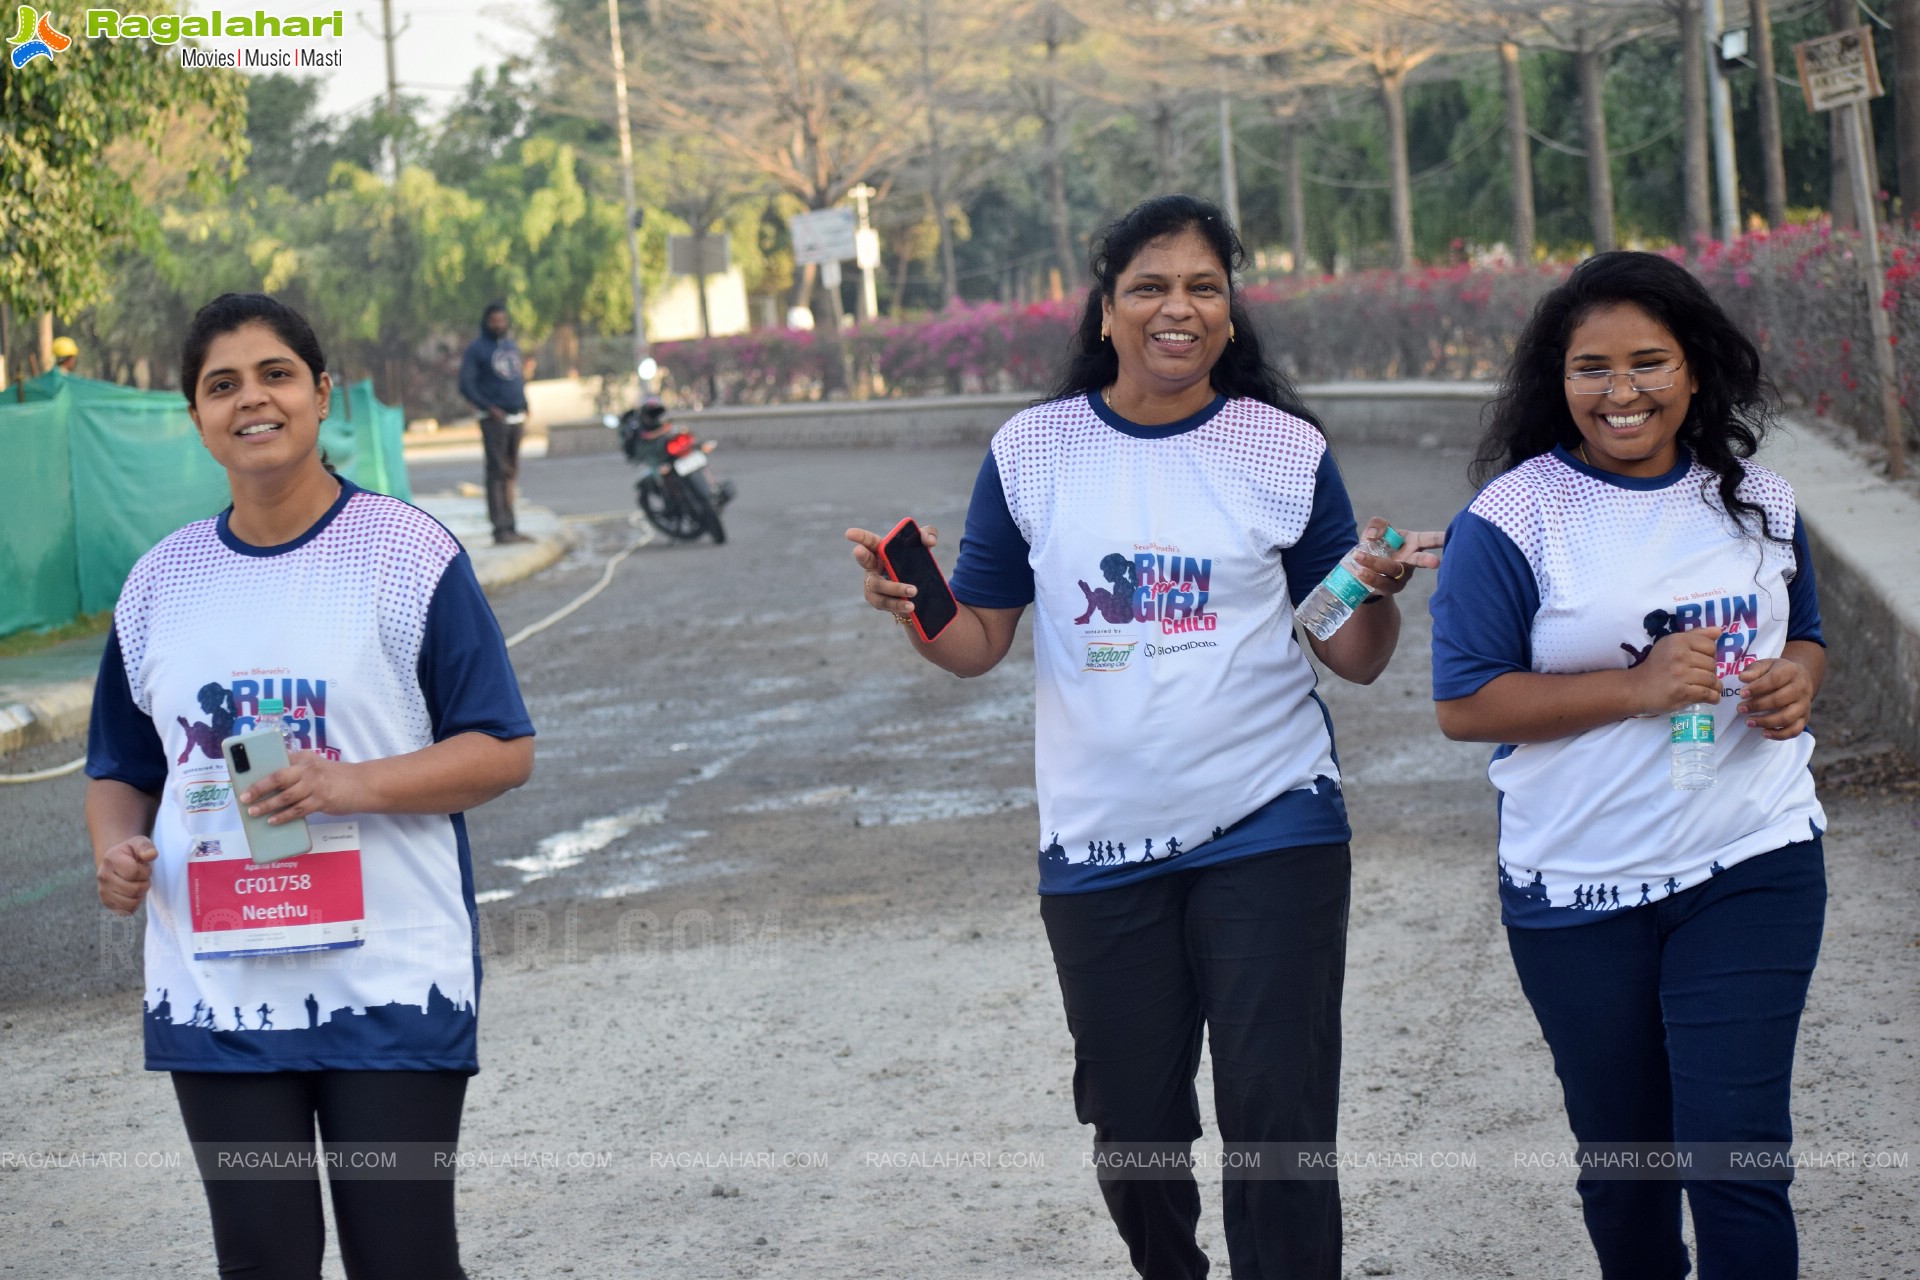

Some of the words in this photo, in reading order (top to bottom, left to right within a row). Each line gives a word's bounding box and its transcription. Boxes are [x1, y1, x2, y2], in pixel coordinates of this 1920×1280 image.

[1134, 553, 1212, 592] RUN
[1151, 581, 1176, 601] for
[1180, 581, 1193, 593] a
[1132, 586, 1218, 623] GIRL
[1676, 593, 1758, 632] RUN
[1161, 615, 1217, 636] CHILD
[1086, 647, 1131, 663] Freedom
[232, 678, 327, 717] RUN
[234, 874, 312, 895] CF01758
[241, 902, 308, 921] Neethu
